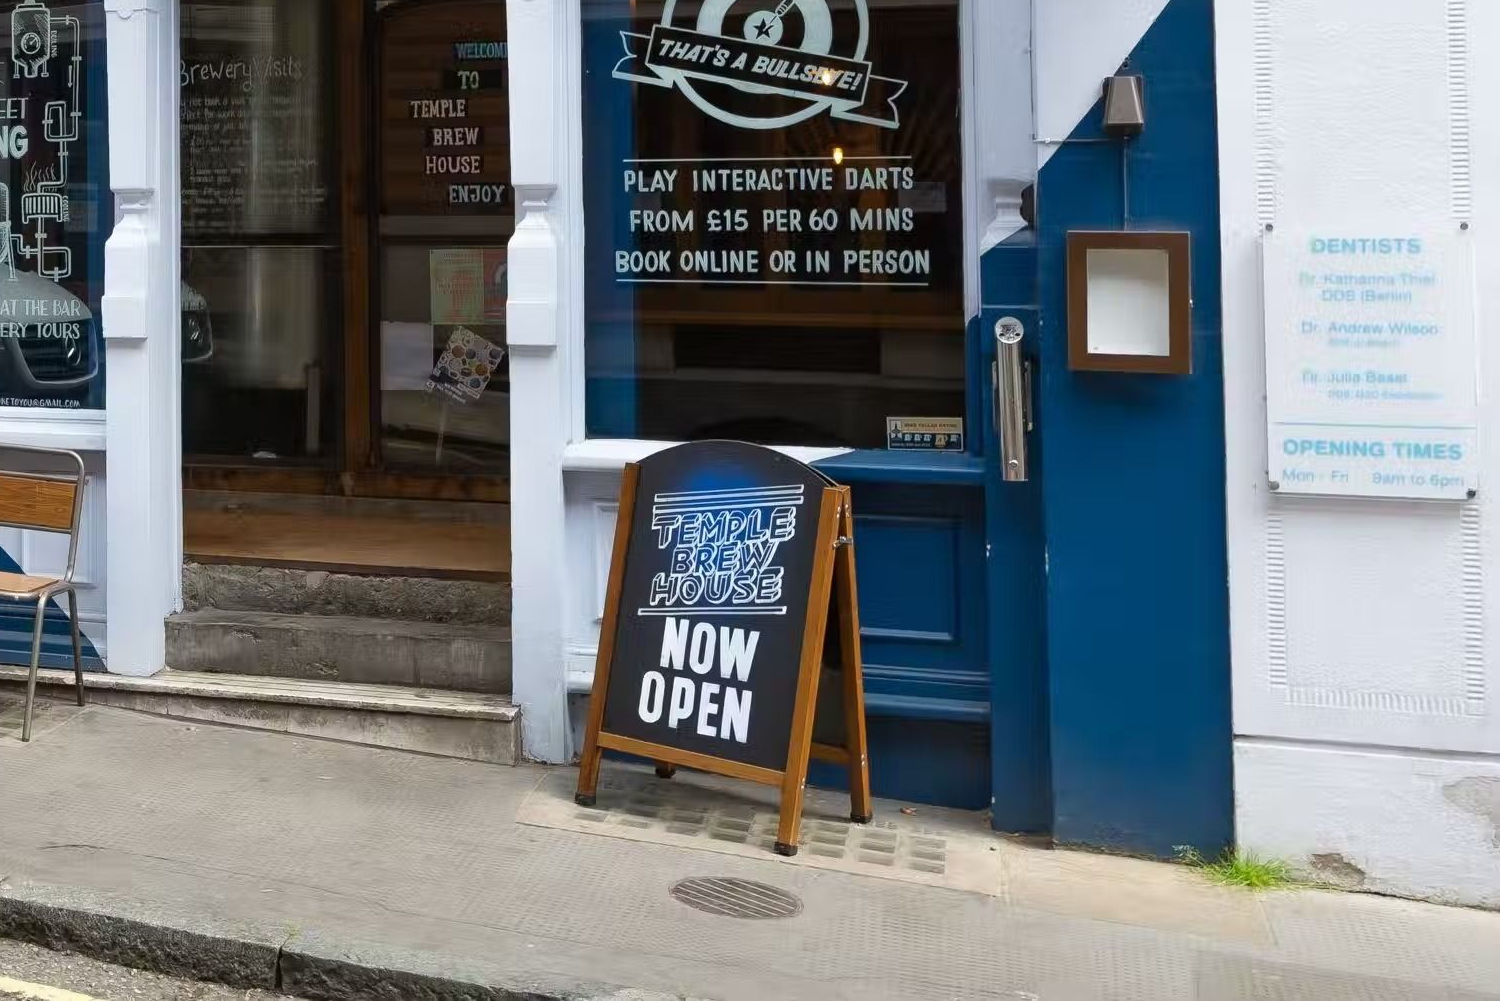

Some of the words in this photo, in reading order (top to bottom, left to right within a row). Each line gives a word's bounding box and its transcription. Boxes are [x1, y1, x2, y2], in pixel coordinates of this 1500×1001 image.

[457, 42, 508, 59] WELCOM
[658, 39, 729, 68] THAT'S
[730, 52, 748, 70] A
[752, 56, 864, 91] BULLSEYE!
[458, 70, 480, 90] TO
[410, 99, 466, 118] TEMPLE
[433, 127, 479, 146] BREW
[425, 155, 481, 174] HOUSE
[623, 170, 678, 193] PLAY
[693, 168, 833, 192] INTERACTIVE
[845, 167, 914, 191] DARTS
[449, 185, 506, 204] ENJOY
[630, 209, 694, 232] FROM
[707, 208, 749, 232] £15
[763, 208, 802, 231] PER
[809, 208, 838, 231] 60
[850, 208, 914, 231] MINS
[1310, 238, 1422, 254] DENTISTS
[615, 251, 671, 273] BOOK
[680, 250, 759, 273] ONLINE
[769, 250, 797, 273] OR
[806, 250, 831, 273] IN
[843, 250, 931, 274] PERSON
[0, 299, 19, 316] AT
[23, 299, 48, 316] THE
[52, 299, 80, 316] BAR
[36, 322, 80, 340] TOURS
[1328, 321, 1385, 334] Andrew
[1389, 322, 1438, 335] Wilson
[1282, 439, 1385, 458] OPENING
[1392, 442, 1463, 461] TIMES
[1283, 469, 1315, 483] Mon
[1410, 473, 1425, 486] to
[652, 506, 796, 548] TEMPLE
[671, 541, 780, 577] BREW
[650, 566, 785, 606] HOUSE
[660, 616, 760, 682] NOW
[638, 670, 753, 744] OPEN
